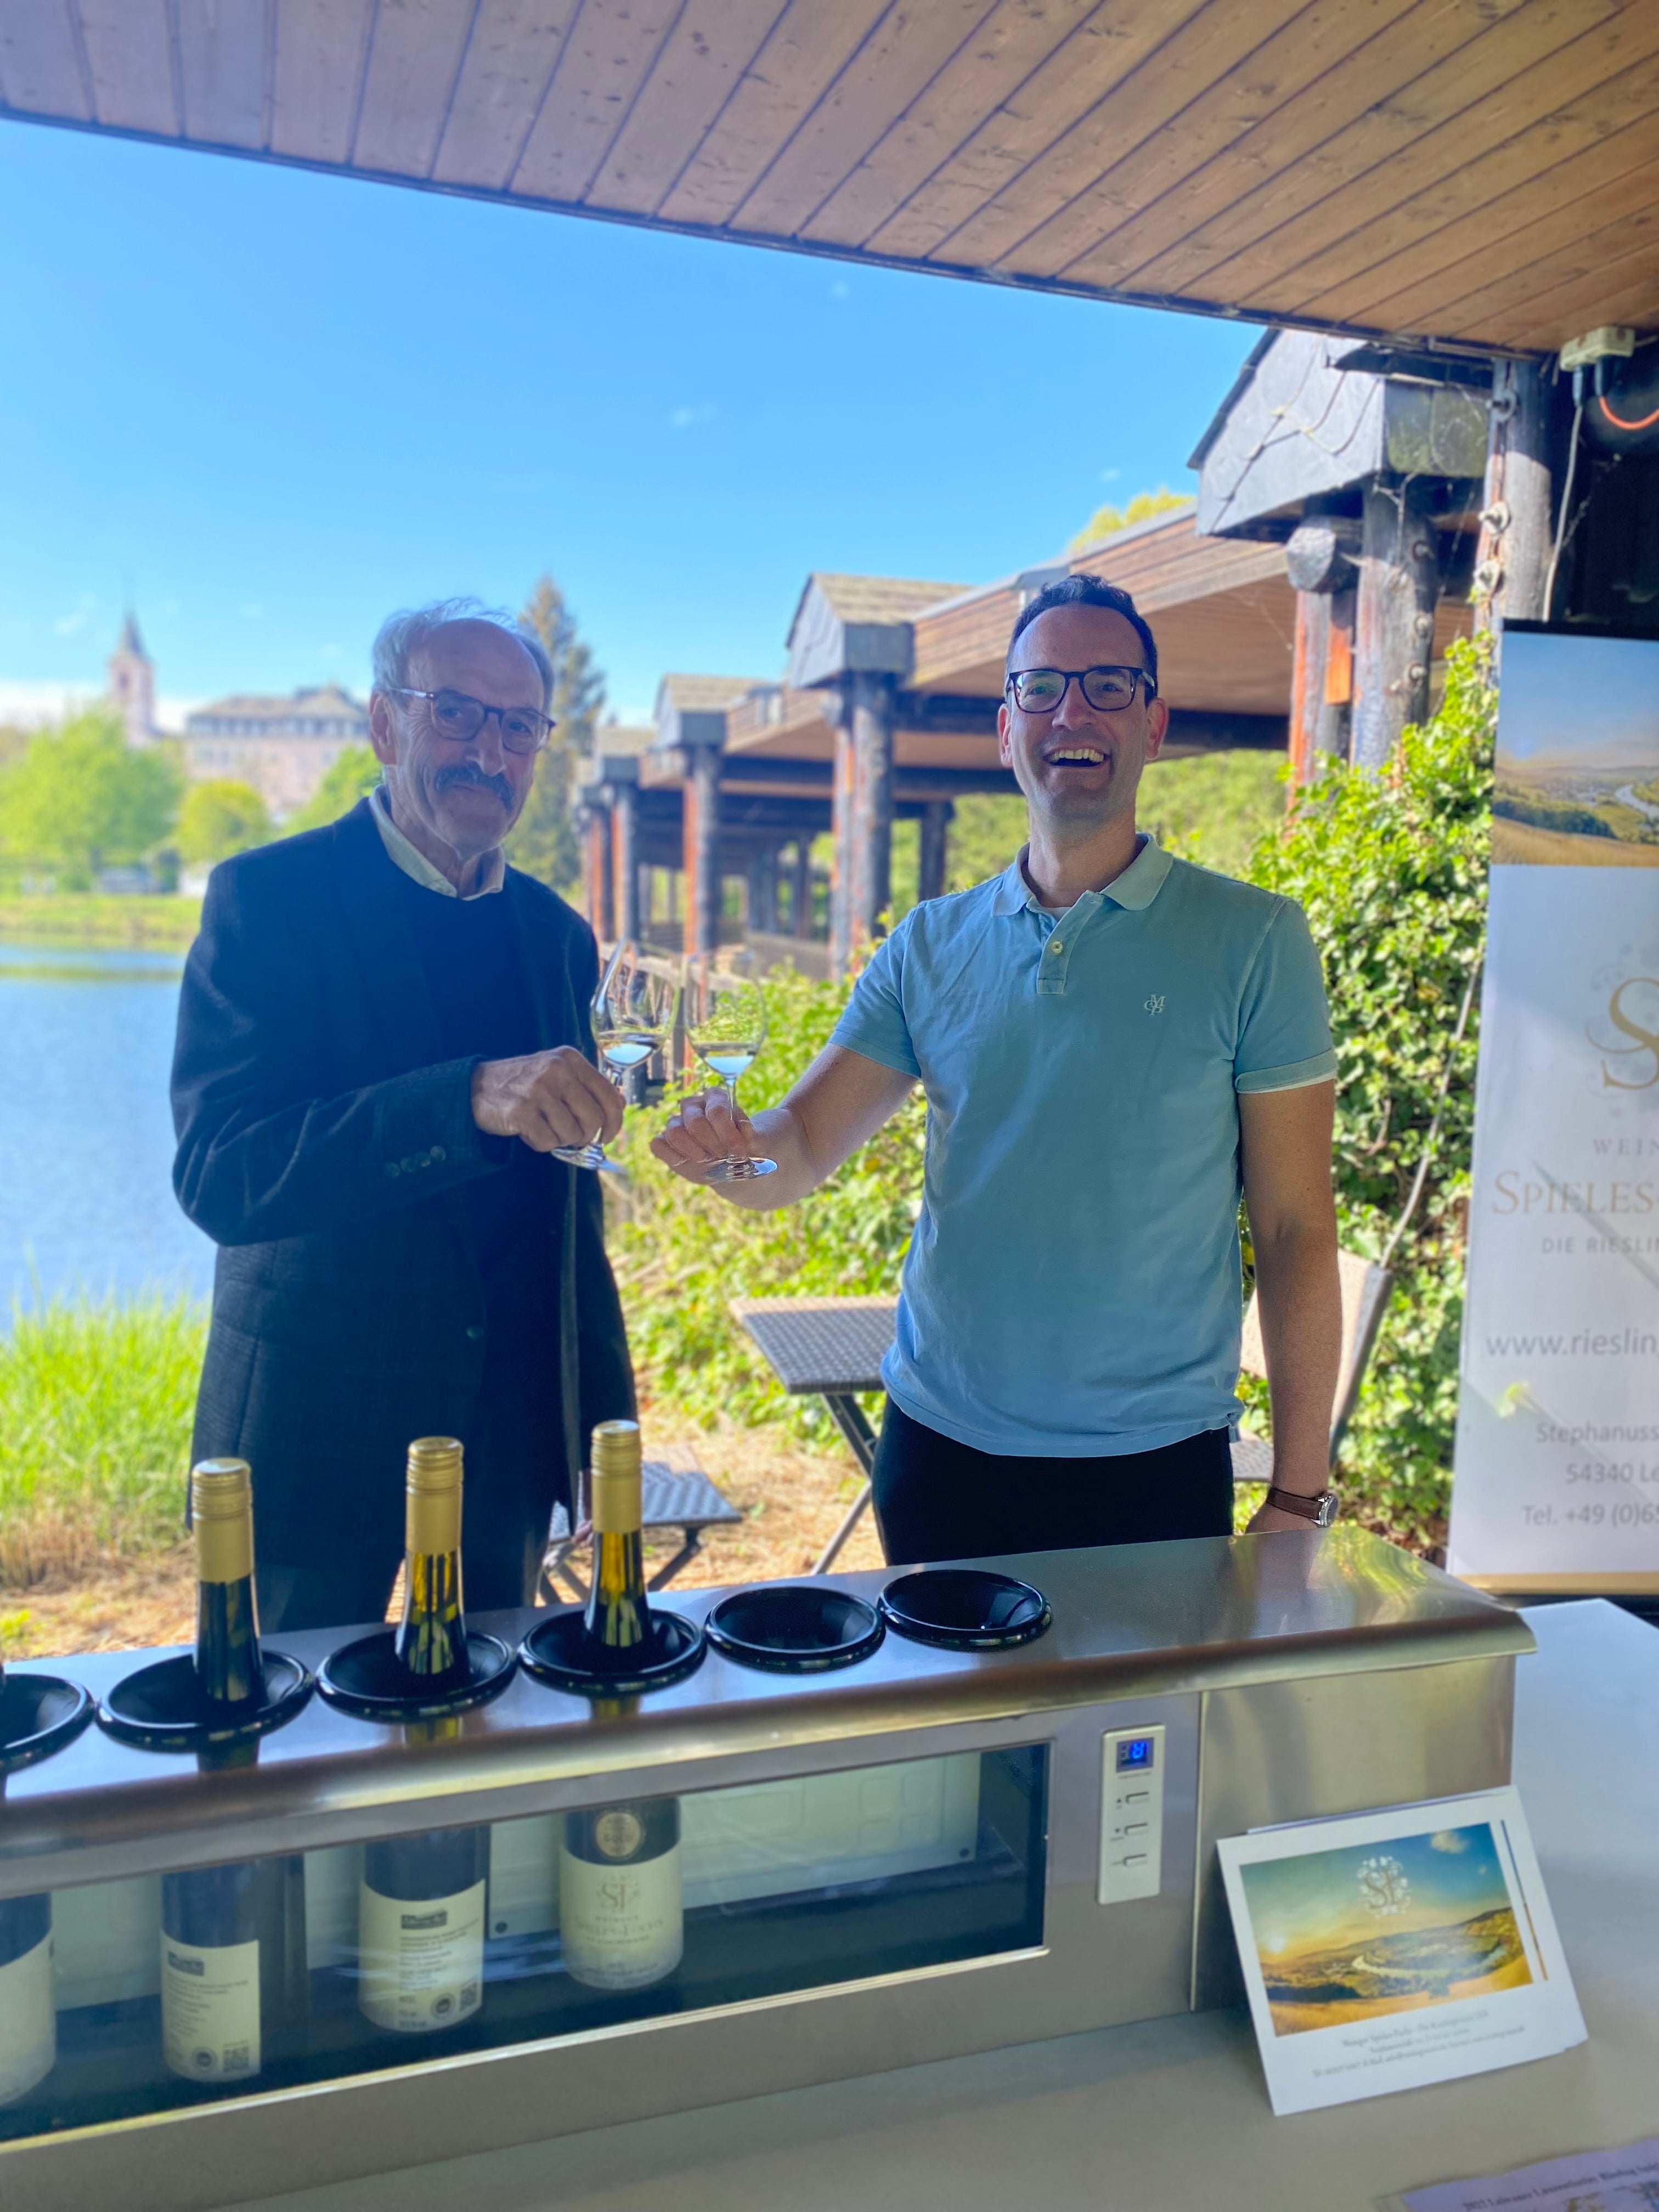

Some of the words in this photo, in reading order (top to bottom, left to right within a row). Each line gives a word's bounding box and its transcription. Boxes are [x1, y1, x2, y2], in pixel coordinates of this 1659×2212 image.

[1541, 1236, 1576, 1255] DIE
[1486, 1327, 1659, 1357] www.rieslin
[1566, 1462, 1634, 1484] 54340
[1522, 1504, 1559, 1526] Tel.
[1565, 1503, 1605, 1526] +49
